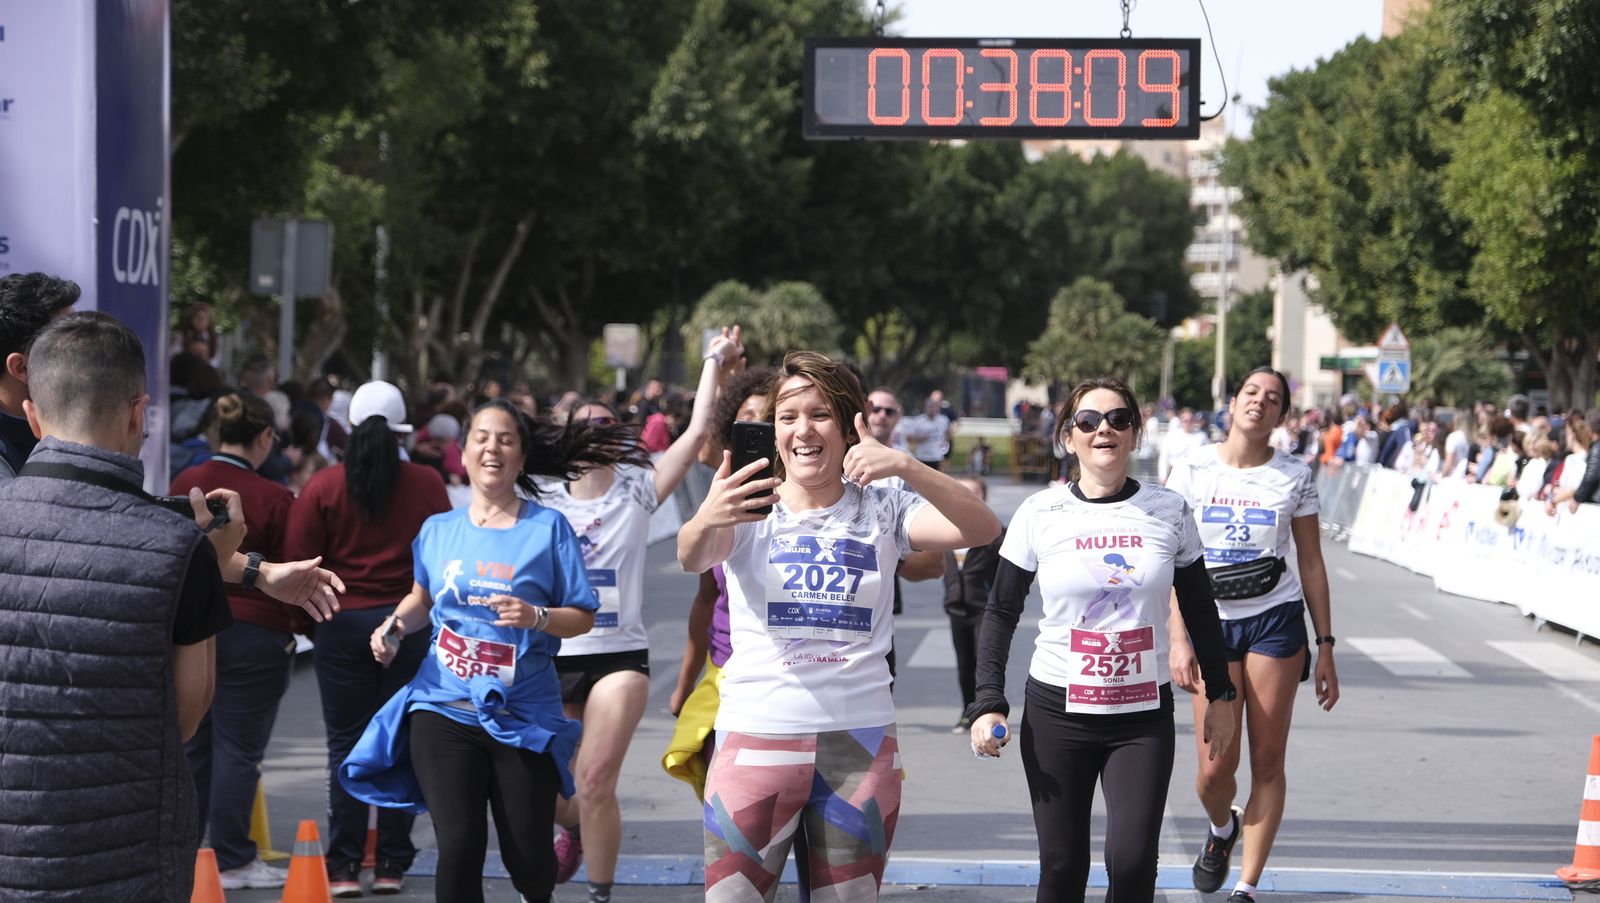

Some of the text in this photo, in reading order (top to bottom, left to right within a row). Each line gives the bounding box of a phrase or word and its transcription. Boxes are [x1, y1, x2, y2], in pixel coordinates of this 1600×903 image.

[868, 48, 1181, 127] 00:38:09
[1076, 535, 1144, 550] MUJER
[1225, 525, 1251, 542] 23
[476, 559, 515, 582] VIII
[783, 564, 864, 595] 2027
[469, 578, 513, 592] CARRERA
[791, 591, 828, 600] CARMEN
[1080, 652, 1142, 677] 2521
